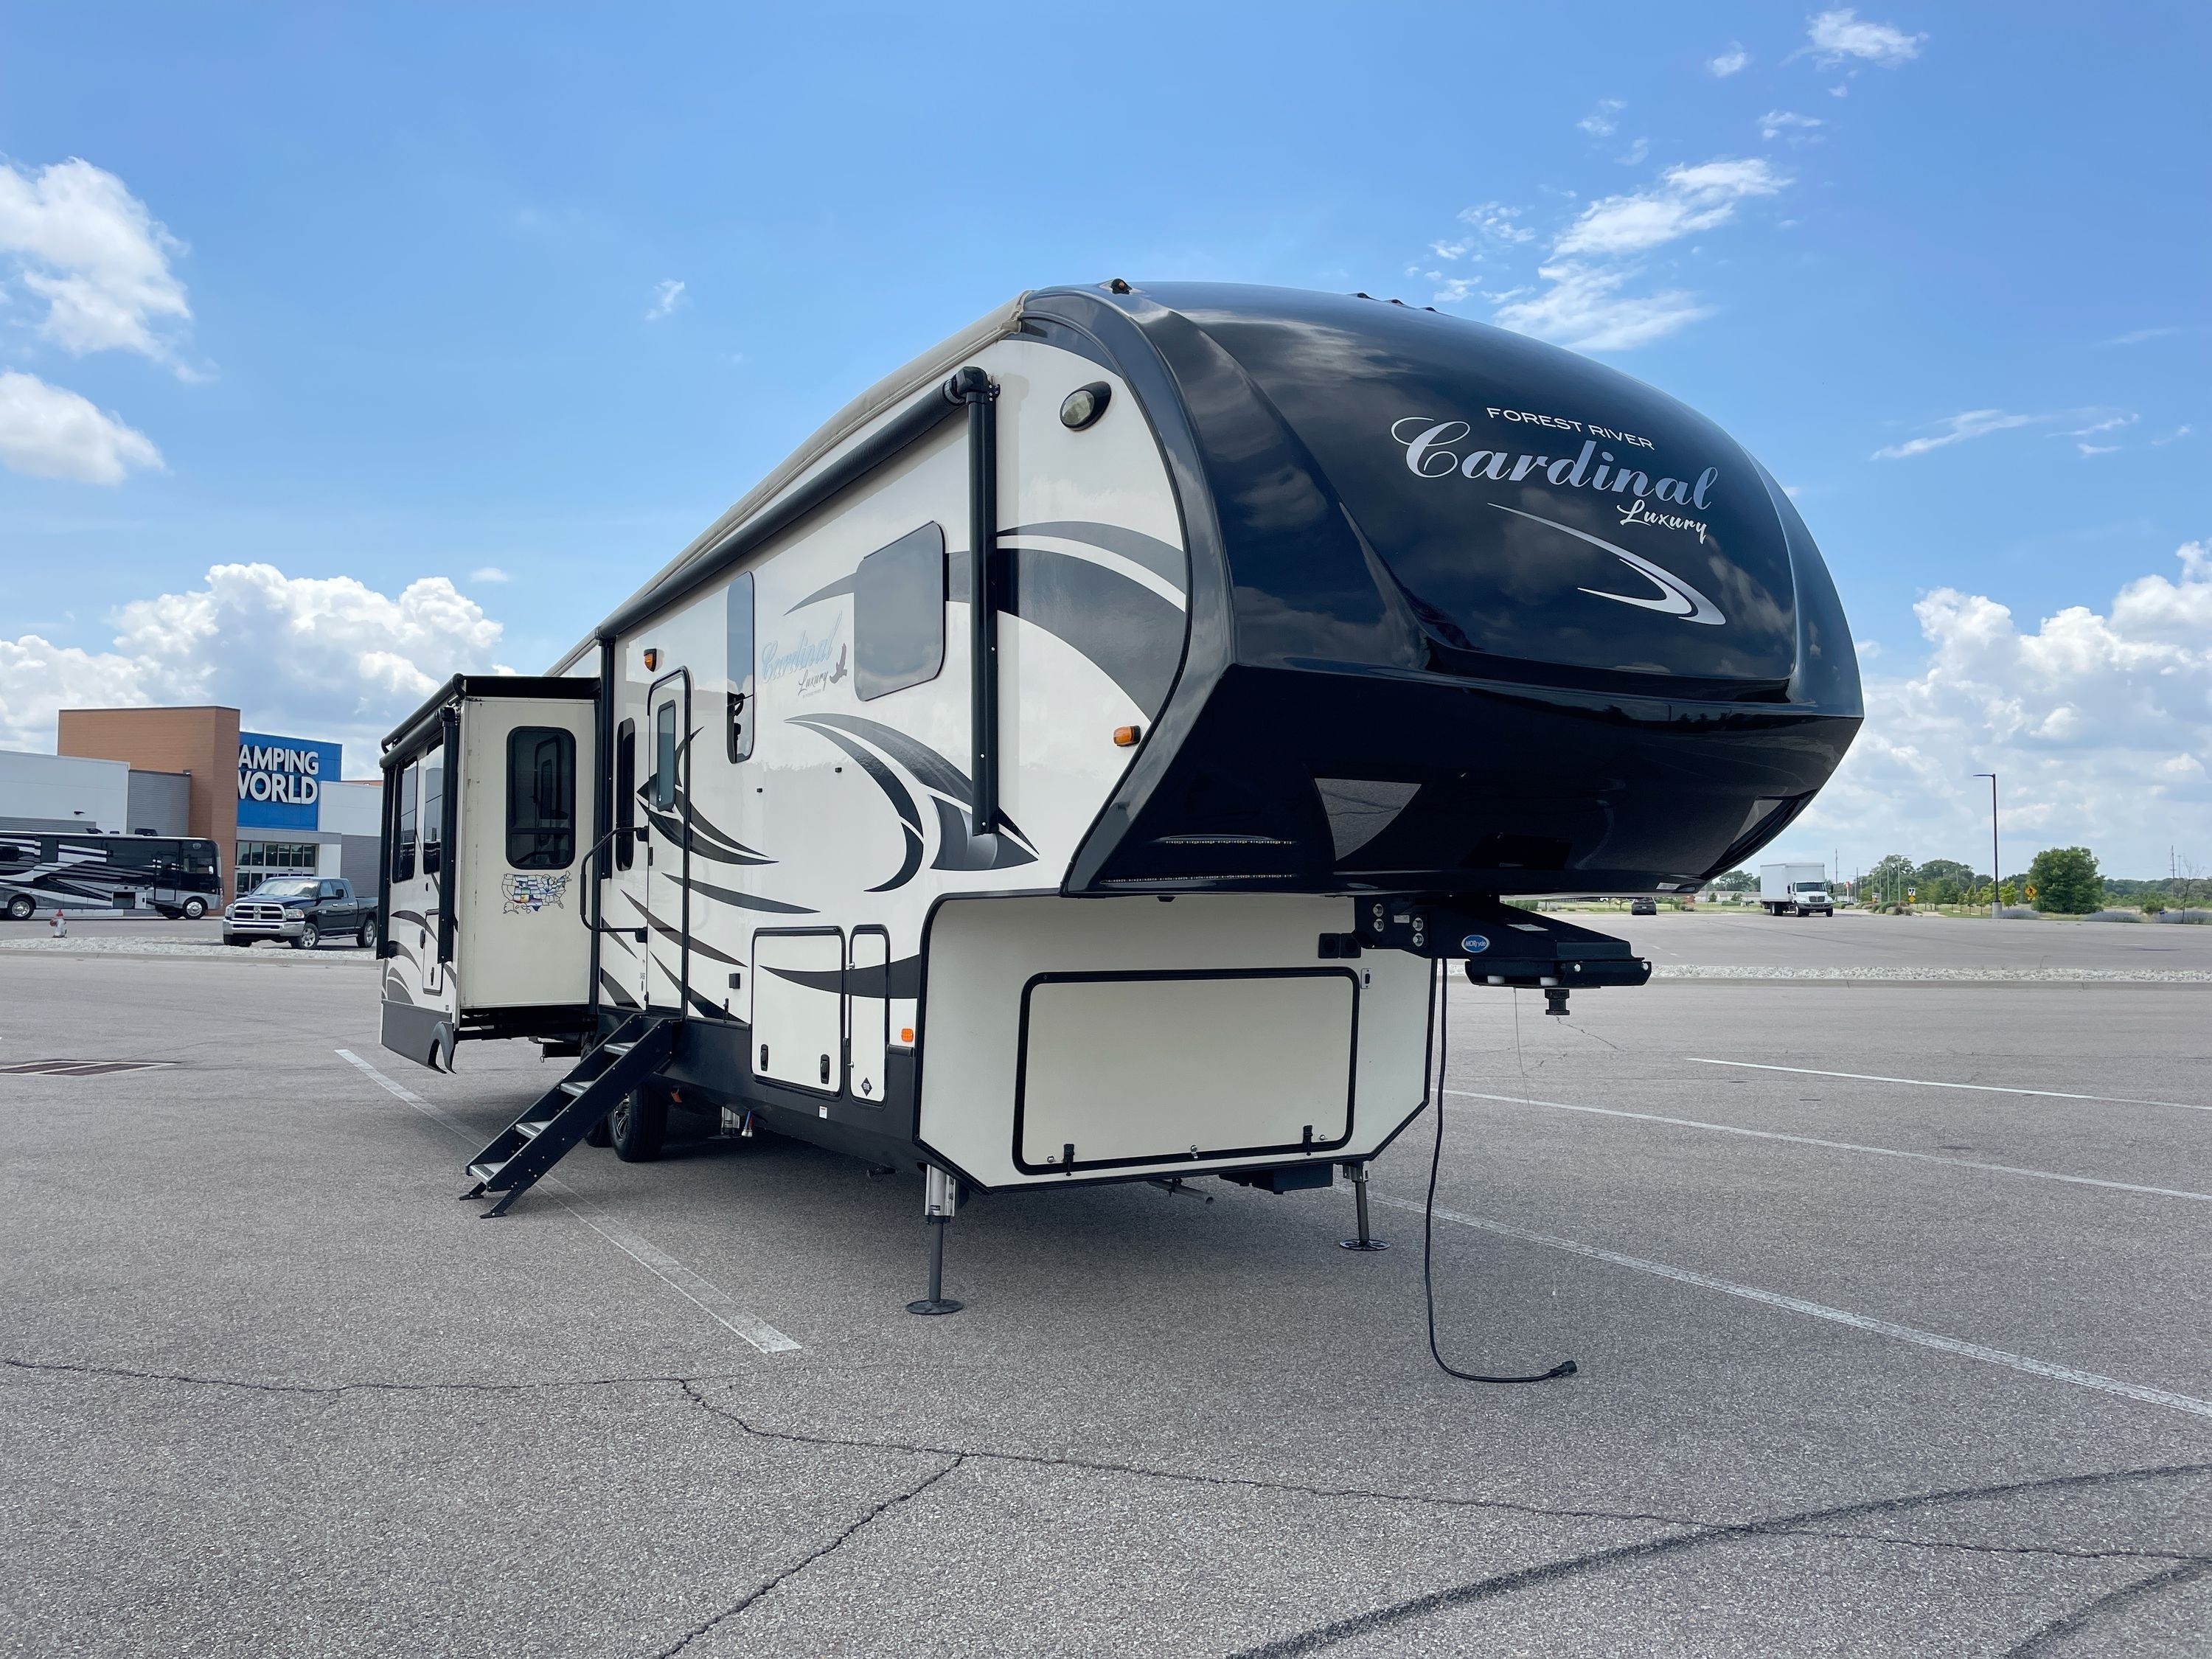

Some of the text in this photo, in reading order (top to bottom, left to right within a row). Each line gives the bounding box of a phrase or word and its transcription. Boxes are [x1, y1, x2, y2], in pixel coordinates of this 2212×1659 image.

[1486, 407, 1655, 451] FOREST RIVER
[1391, 417, 1719, 509] Cardinal
[1617, 499, 1708, 544] Luxury
[762, 610, 842, 684] Cardinal
[798, 669, 828, 696] Luxury
[238, 744, 319, 775] AMPING
